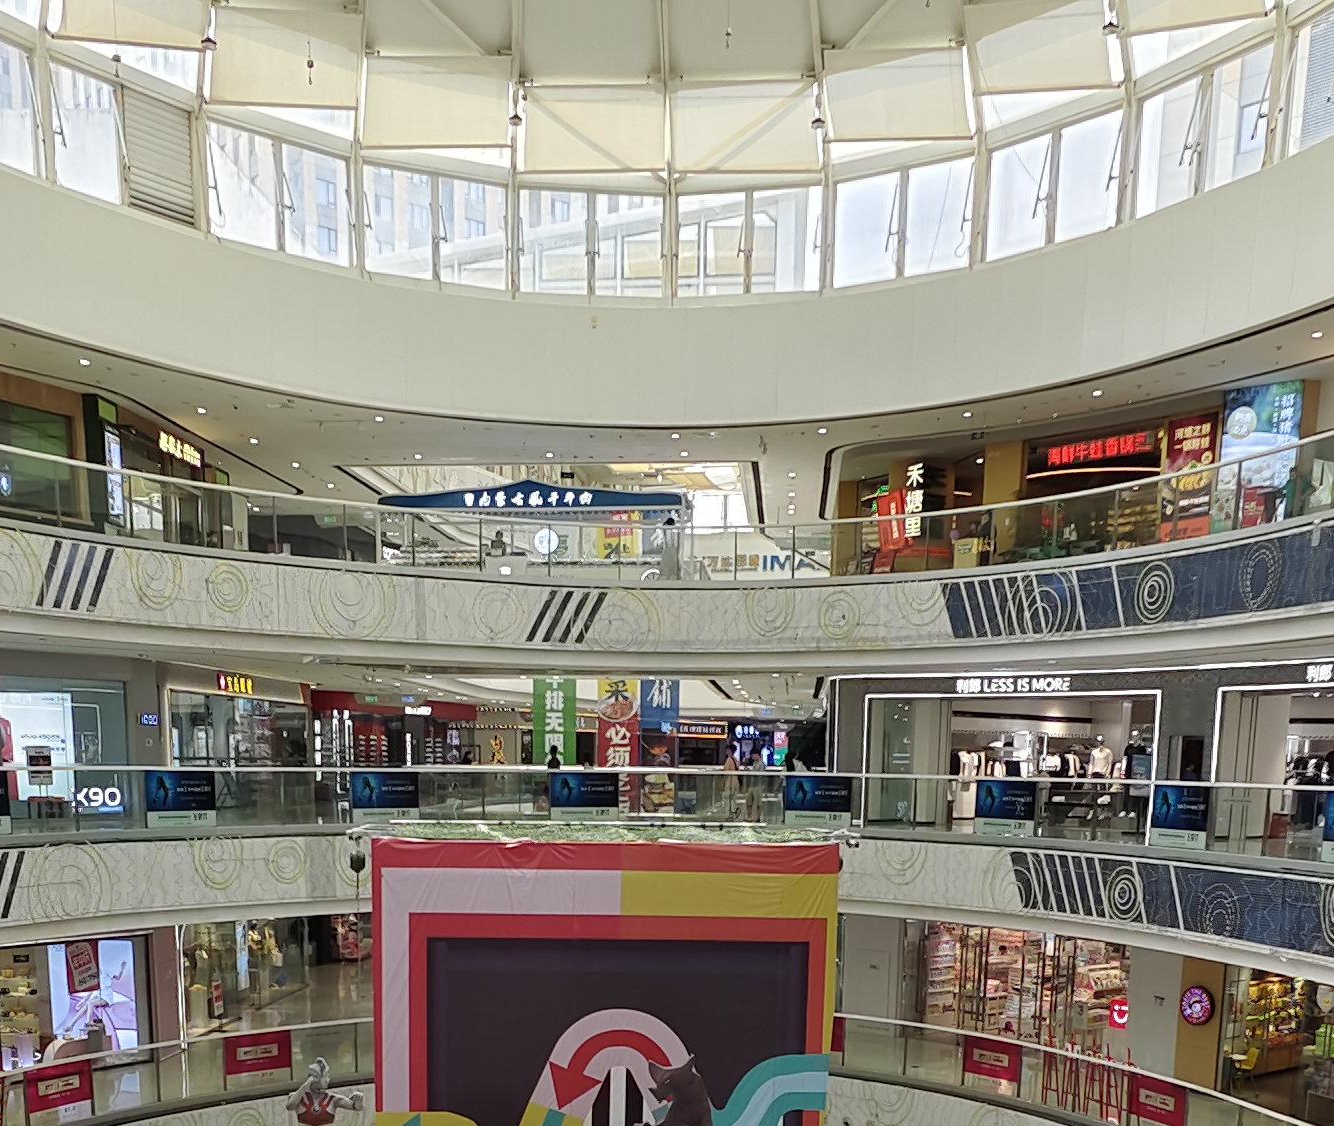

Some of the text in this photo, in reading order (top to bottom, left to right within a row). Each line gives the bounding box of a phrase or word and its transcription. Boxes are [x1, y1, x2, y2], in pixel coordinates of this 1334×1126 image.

[904, 462, 924, 538] 禾塘里
[983, 678, 1014, 692] LESS
[1017, 678, 1030, 691] IS
[1032, 677, 1071, 691] MORE
